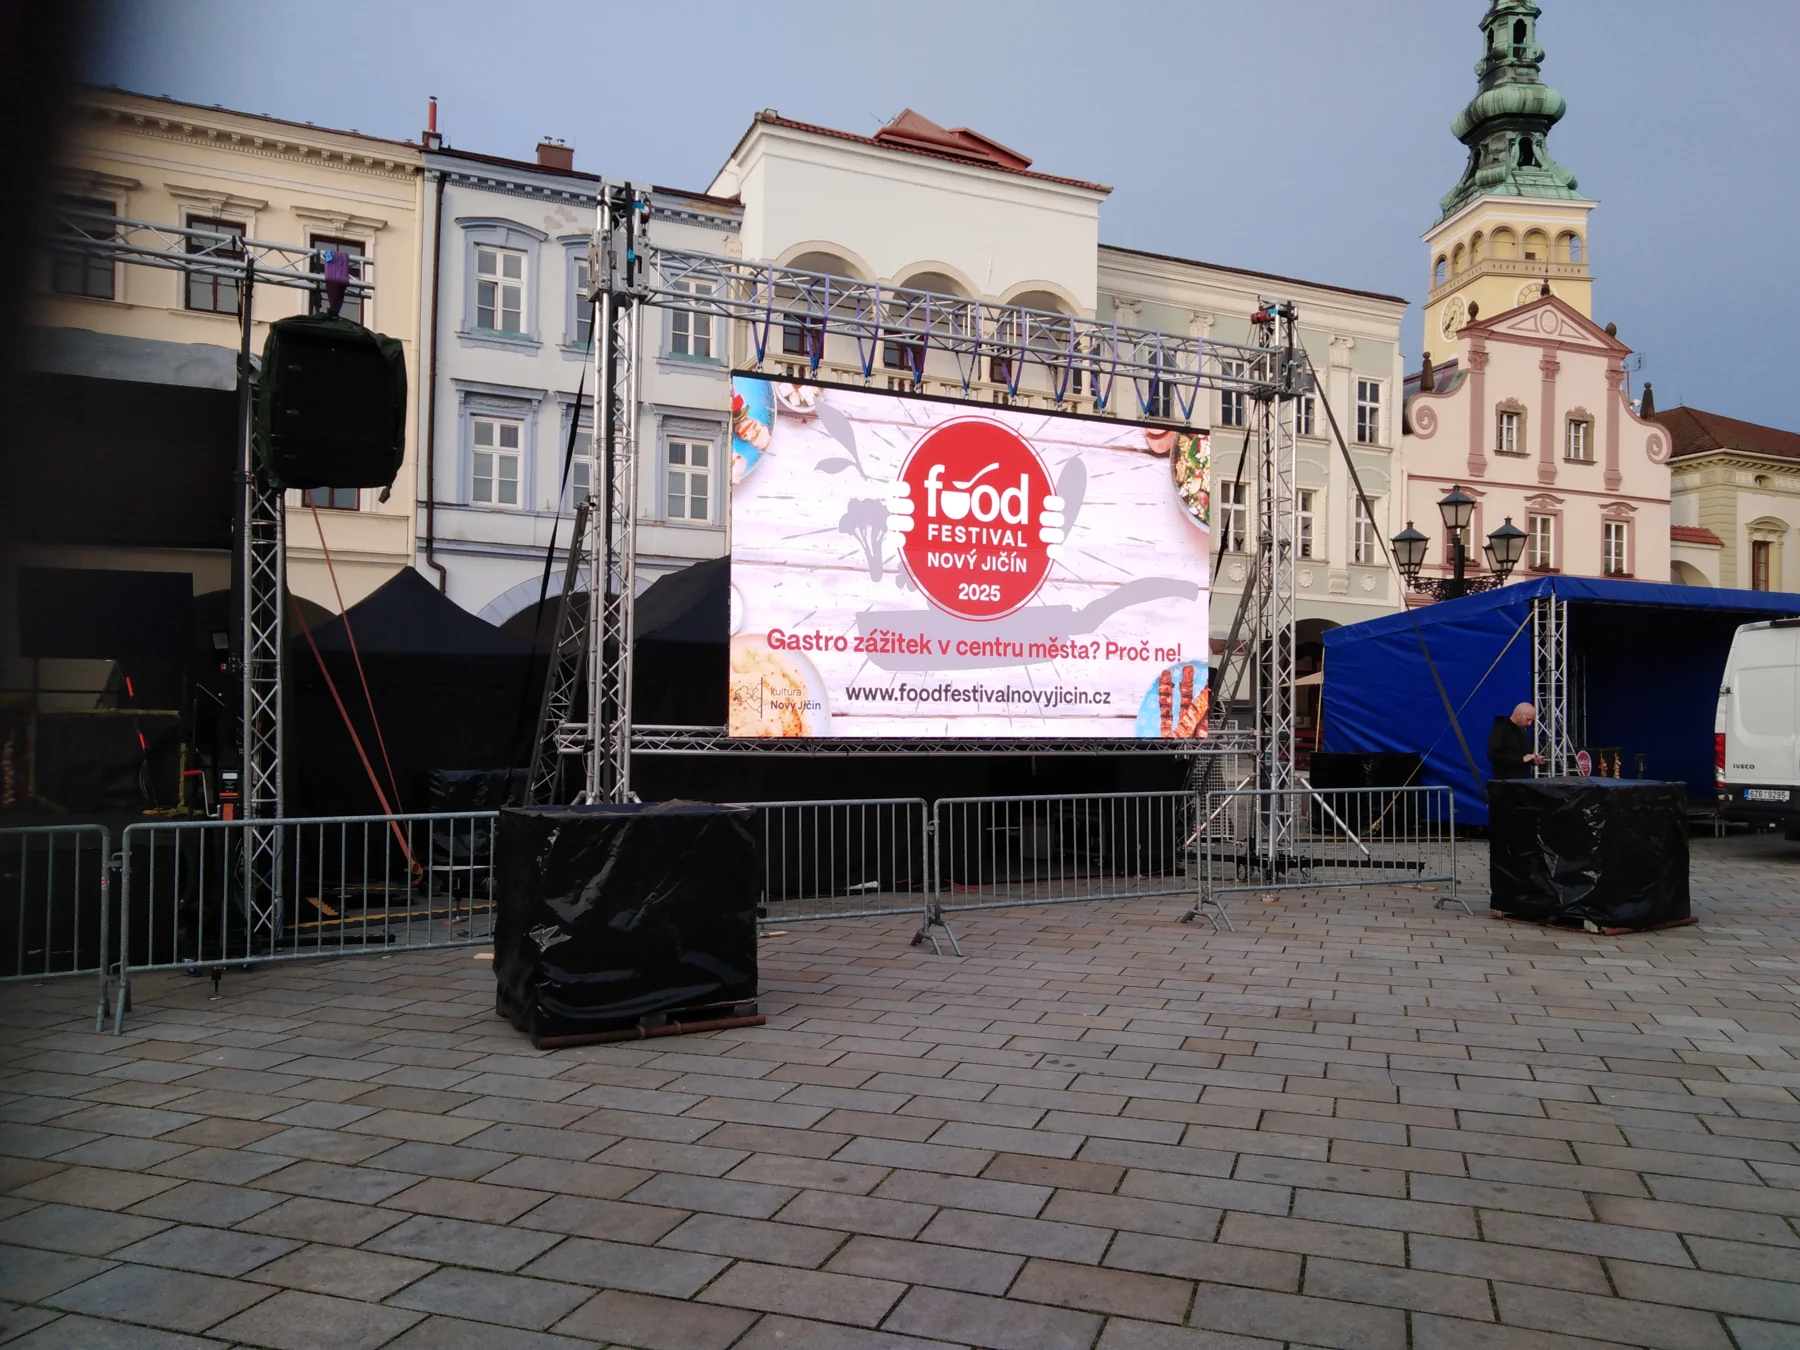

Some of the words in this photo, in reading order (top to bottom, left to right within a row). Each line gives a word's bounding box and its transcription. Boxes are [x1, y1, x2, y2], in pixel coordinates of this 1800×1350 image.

[924, 463, 1029, 525] food
[928, 524, 1028, 547] FESTIVAL
[927, 549, 977, 570] NOVÝ
[981, 551, 1027, 573] JIČÍN
[958, 583, 1001, 602] 2025
[767, 628, 848, 652] Gastro
[853, 628, 932, 655] zážitek
[937, 640, 951, 656] v
[956, 636, 1023, 657] centru
[1028, 636, 1100, 660] města?
[1105, 640, 1150, 662] Proč
[1154, 643, 1181, 663] ne!
[770, 687, 802, 697] kultura
[846, 683, 1111, 708] www.foodfestivalnovyjicin.cz
[798, 699, 821, 711] Jičín
[1767, 790, 1786, 799] 9295
